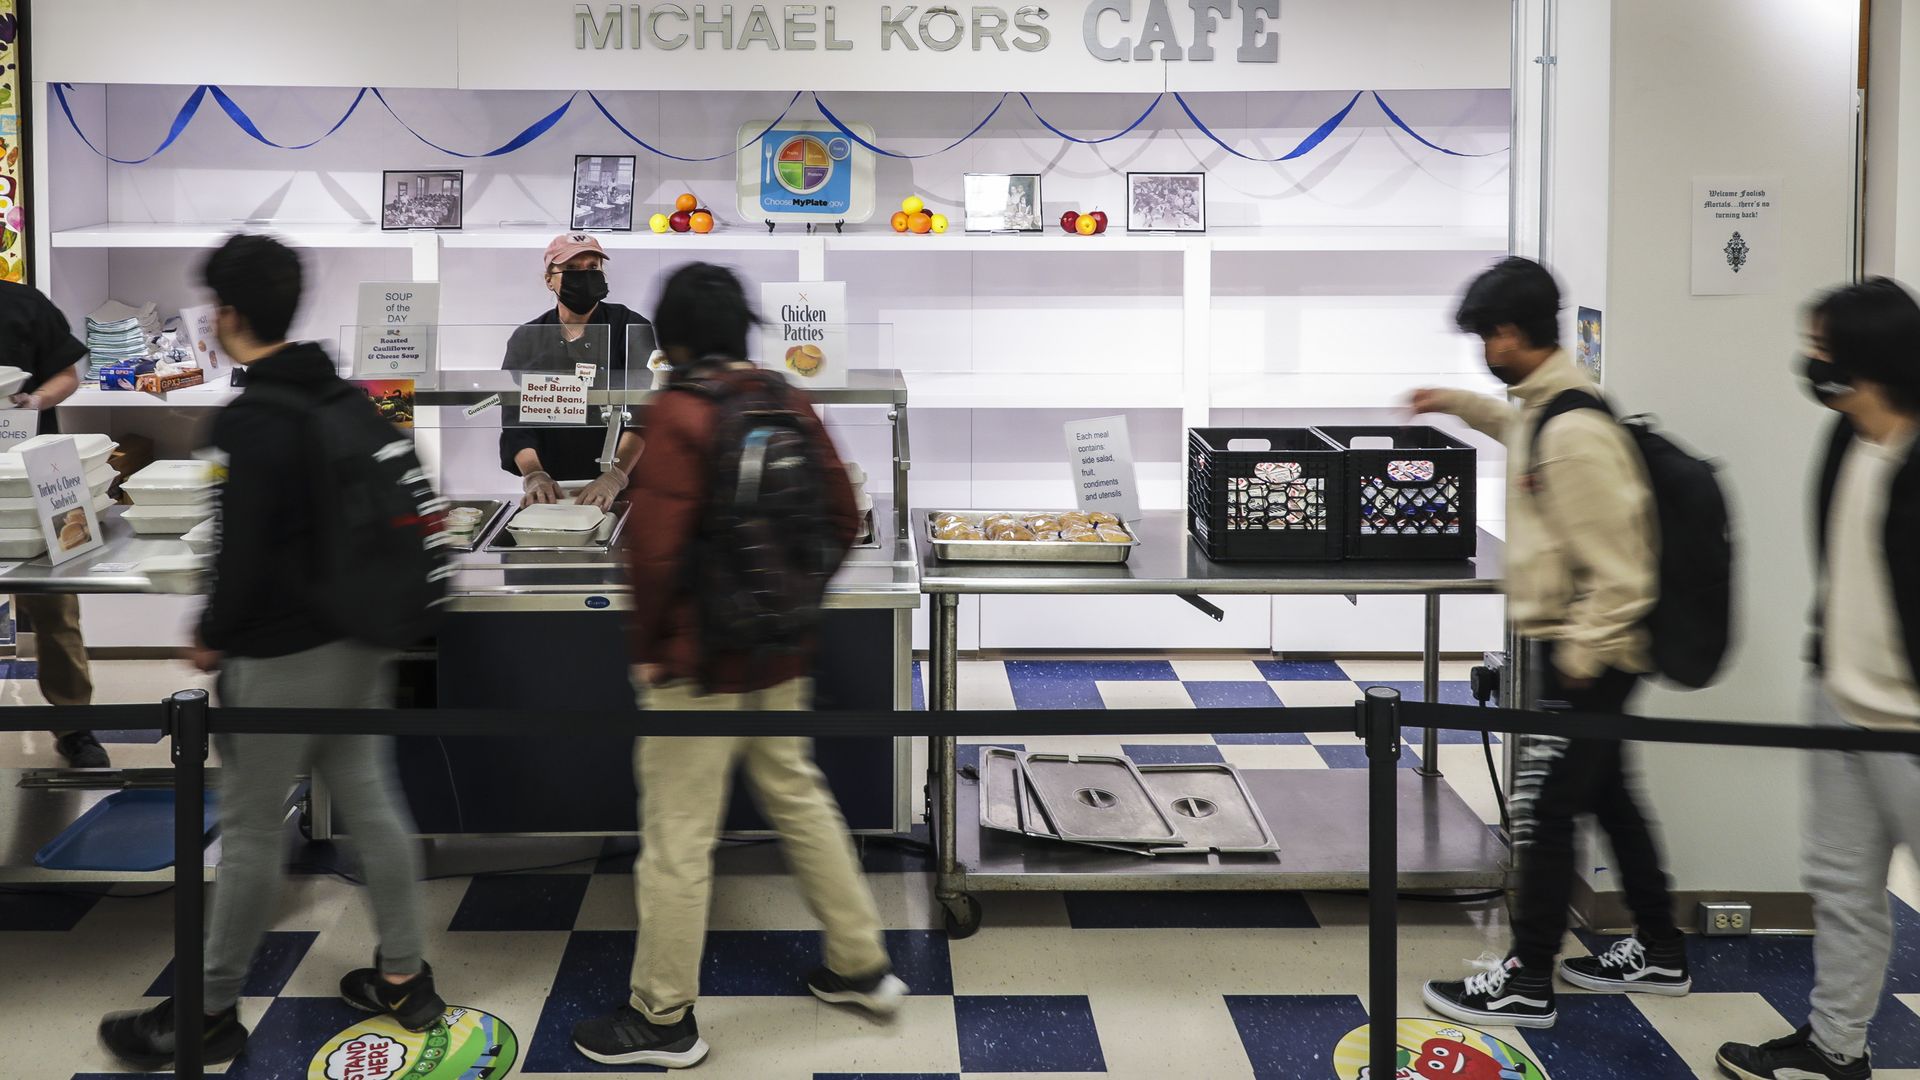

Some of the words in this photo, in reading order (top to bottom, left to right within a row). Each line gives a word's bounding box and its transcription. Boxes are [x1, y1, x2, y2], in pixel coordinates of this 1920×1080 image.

[575, 4, 853, 50] MICHAEL
[881, 5, 1051, 51] KORS
[1083, 0, 1279, 62] CAFE
[1708, 190, 1738, 198] Welcome
[1740, 190, 1766, 198] Foolish
[1715, 211, 1740, 219] turning
[385, 292, 413, 301] SOUP
[385, 303, 395, 312] of
[396, 303, 411, 312] the
[781, 304, 827, 322] Chicken
[387, 314, 408, 323] DAY
[783, 323, 824, 341] Patties
[161, 377, 181, 389] GPX3
[527, 383, 548, 392] Beef
[550, 384, 581, 393] Burrito
[522, 394, 554, 404] Refried
[556, 395, 586, 405] Beans,
[467, 396, 500, 416] Guacamole
[521, 405, 552, 414] Cheese
[553, 406, 561, 414] &
[563, 405, 585, 415] Salsa
[1076, 432, 1093, 440] Each
[1094, 430, 1109, 439] meal
[1082, 456, 1095, 464] side
[1096, 454, 1115, 463] salad,
[37, 482, 57, 497] Turkey
[56, 478, 63, 491] &
[62, 475, 81, 490] Cheese
[1083, 478, 1119, 489] condiments
[51, 490, 78, 509] Sandwich
[1085, 492, 1097, 501] and
[1098, 490, 1122, 500] utensils
[367, 1041, 389, 1076] HERE
